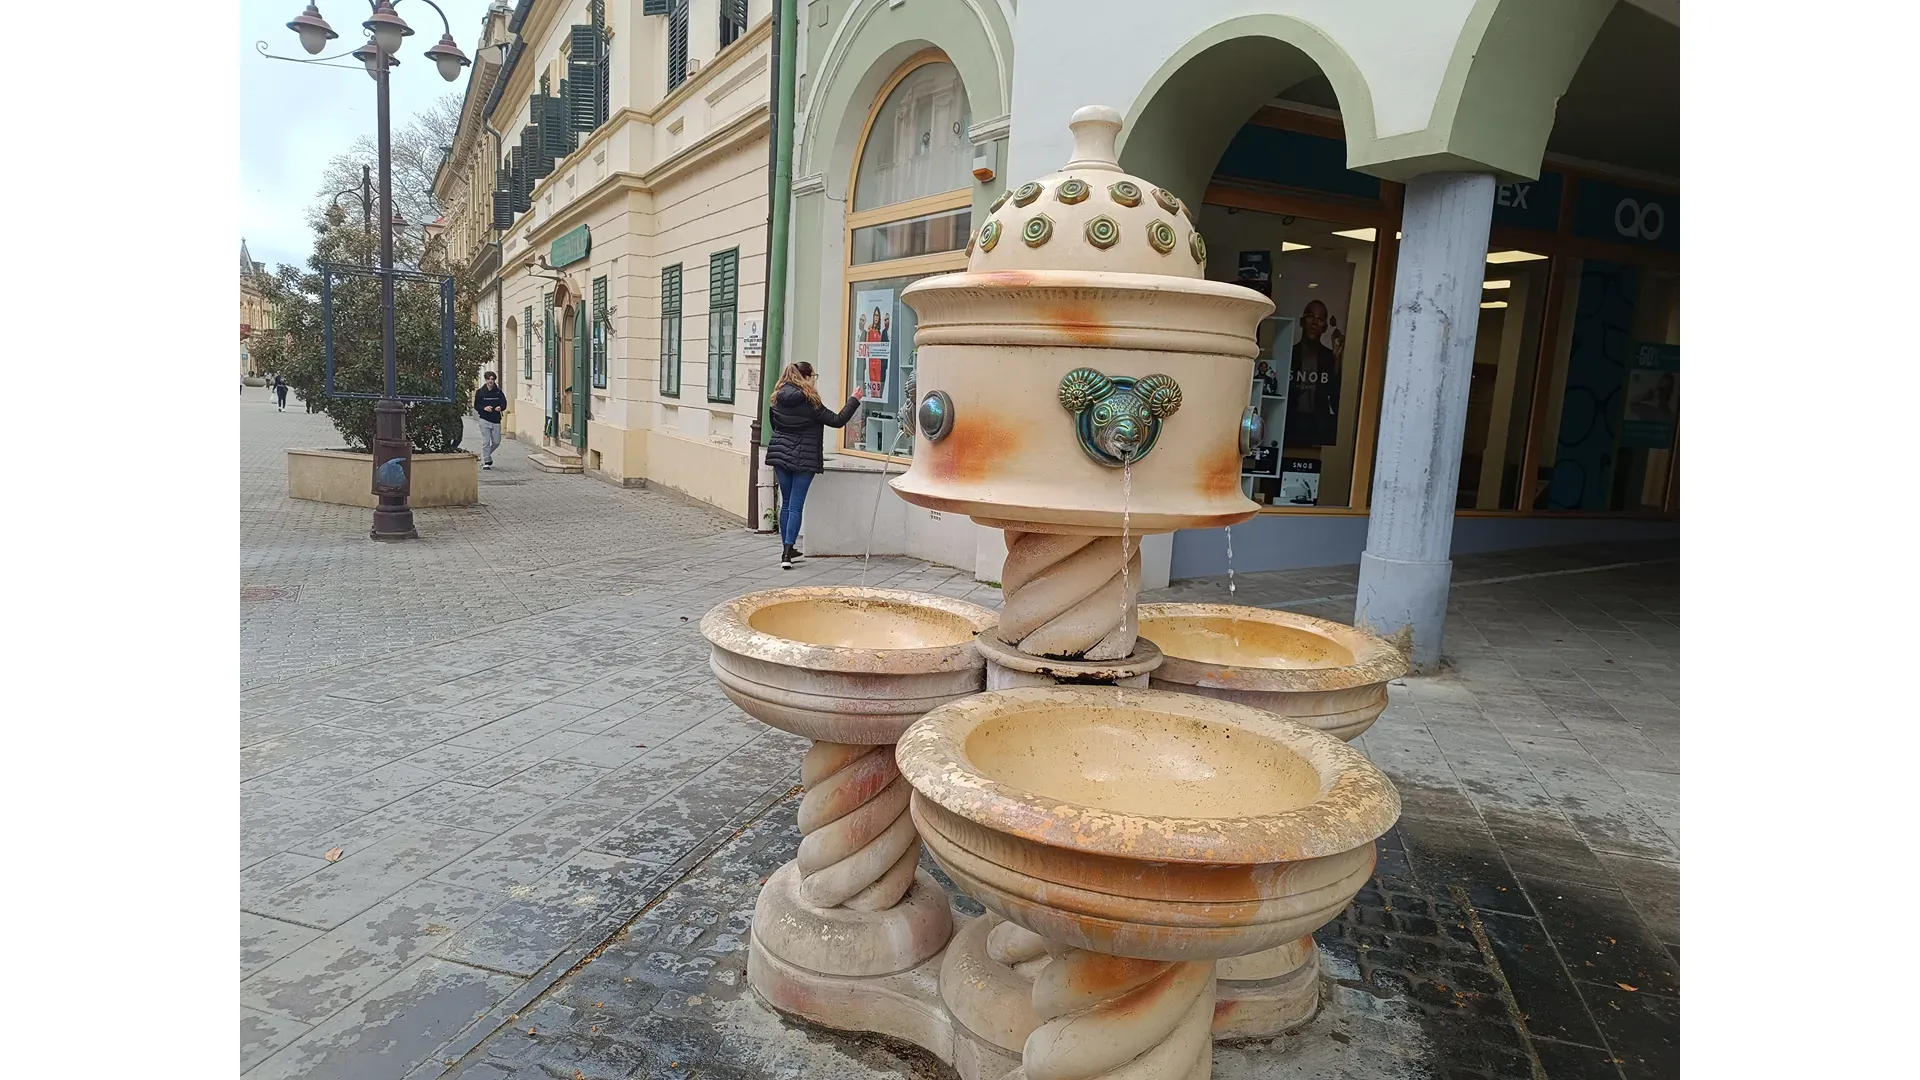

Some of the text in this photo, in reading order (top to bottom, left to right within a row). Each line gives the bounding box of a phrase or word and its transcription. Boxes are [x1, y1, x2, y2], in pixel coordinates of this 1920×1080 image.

[1289, 371, 1329, 384] SNOB
[864, 383, 881, 391] SNOB
[1292, 461, 1313, 469] SNOB
